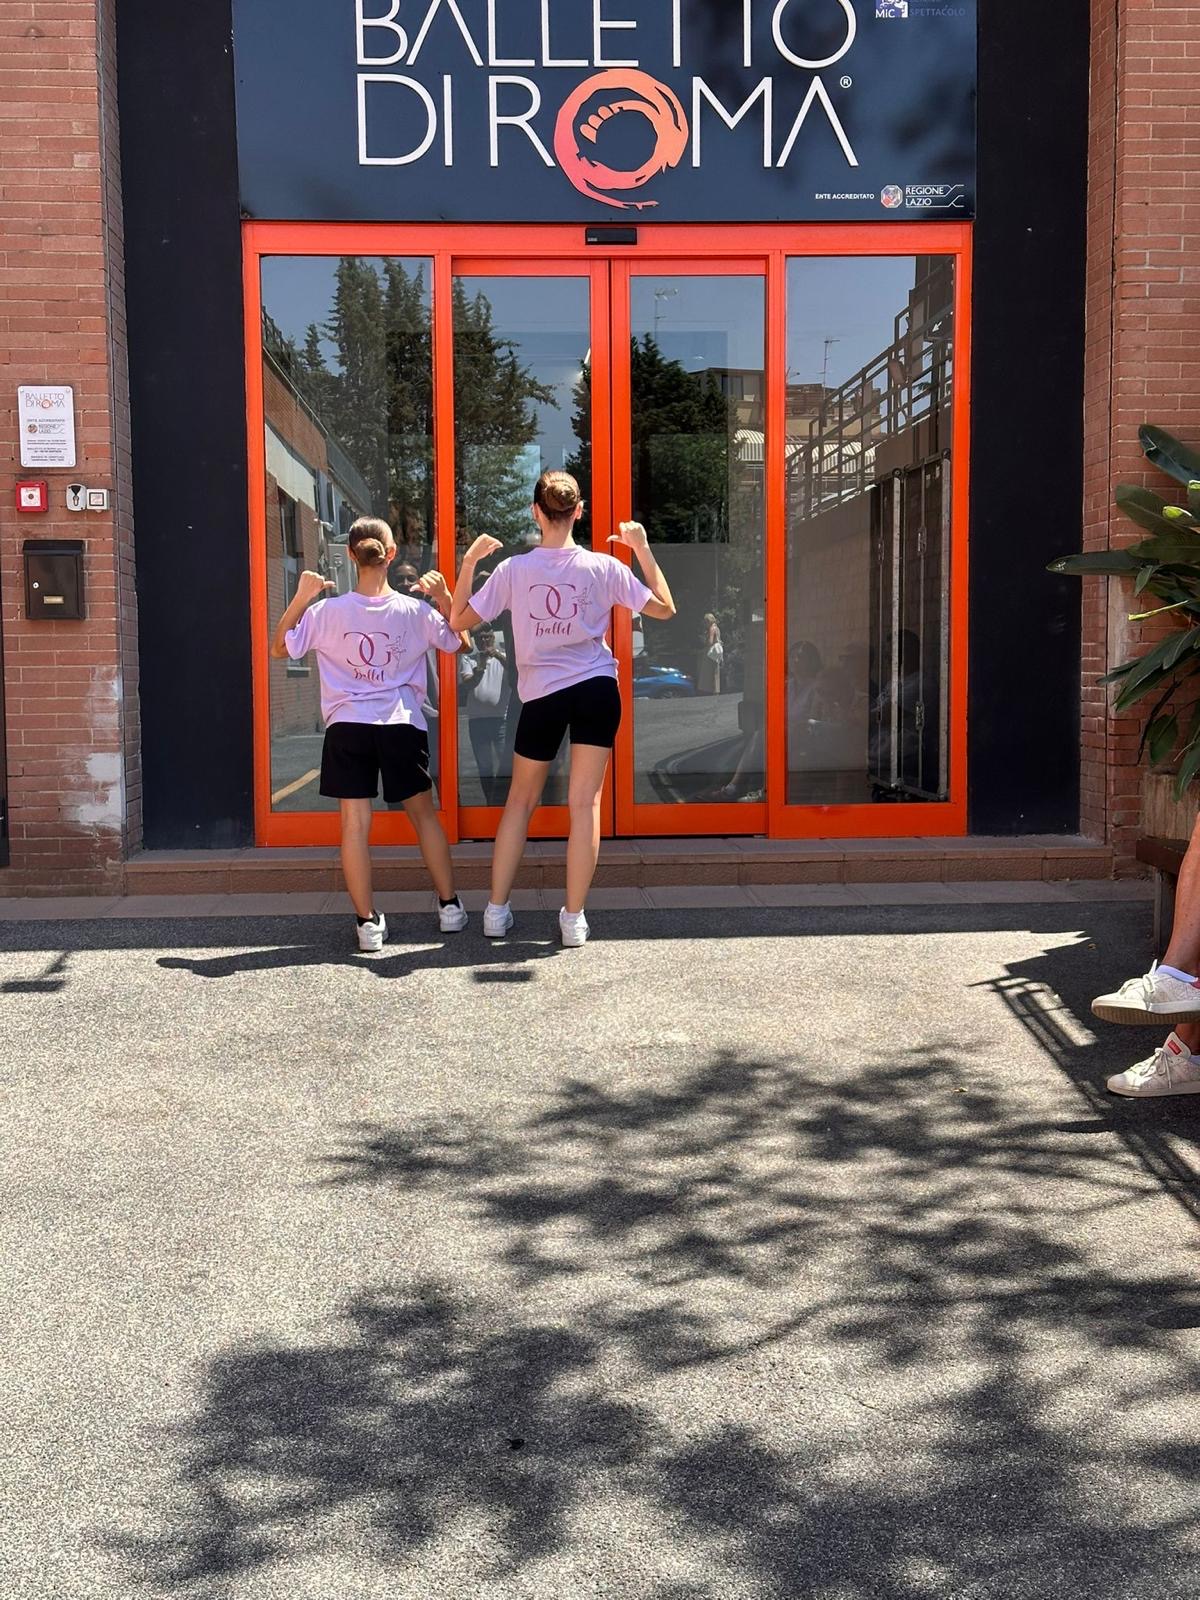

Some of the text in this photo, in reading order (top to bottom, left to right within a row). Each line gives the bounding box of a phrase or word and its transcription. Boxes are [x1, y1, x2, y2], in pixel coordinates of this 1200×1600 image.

[356, 73, 453, 167] DI
[905, 186, 944, 195] REGIONE
[905, 198, 932, 206] LAZIO
[25, 392, 65, 401] BALLETTO
